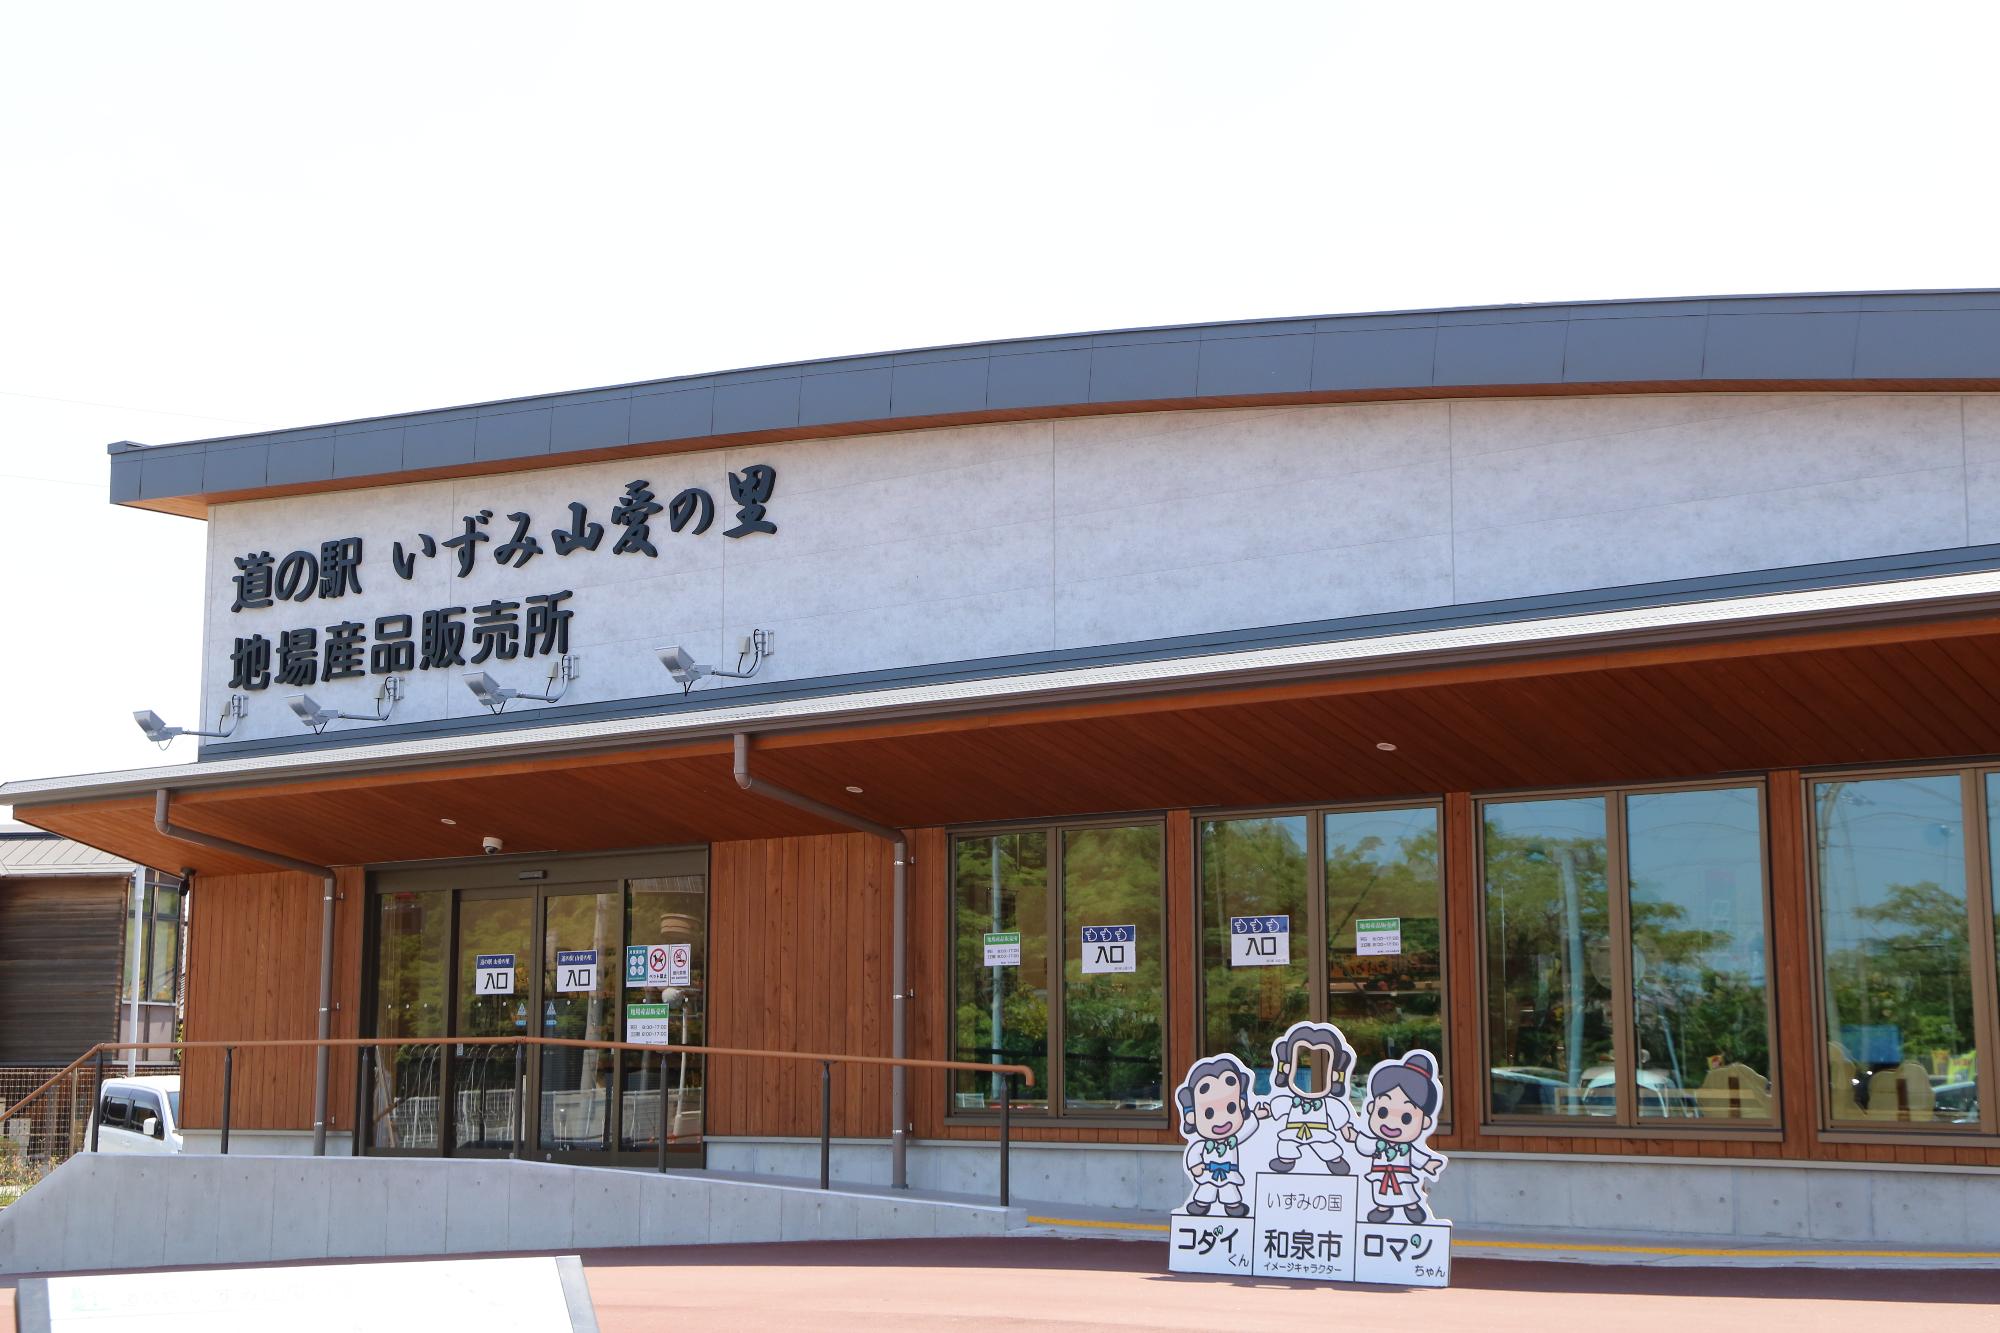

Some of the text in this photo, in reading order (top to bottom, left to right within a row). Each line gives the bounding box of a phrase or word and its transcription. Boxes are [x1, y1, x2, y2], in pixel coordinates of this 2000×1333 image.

[231, 464, 778, 613] 道の駅 いずみ山愛の里
[228, 589, 574, 691] 地場産品販売所
[1095, 945, 1124, 964] 入口
[1245, 936, 1277, 956] 入口
[484, 972, 508, 990] 入口
[566, 968, 591, 987] 入口
[1266, 1193, 1343, 1212] いずみの国
[1178, 1224, 1239, 1256] コダイ
[1263, 1228, 1344, 1262] 和泉市
[1363, 1233, 1433, 1262] ロマン
[1228, 1253, 1250, 1268] くん
[1263, 1261, 1343, 1276] イメージキャラクター
[1414, 1264, 1446, 1279] ちゃん
